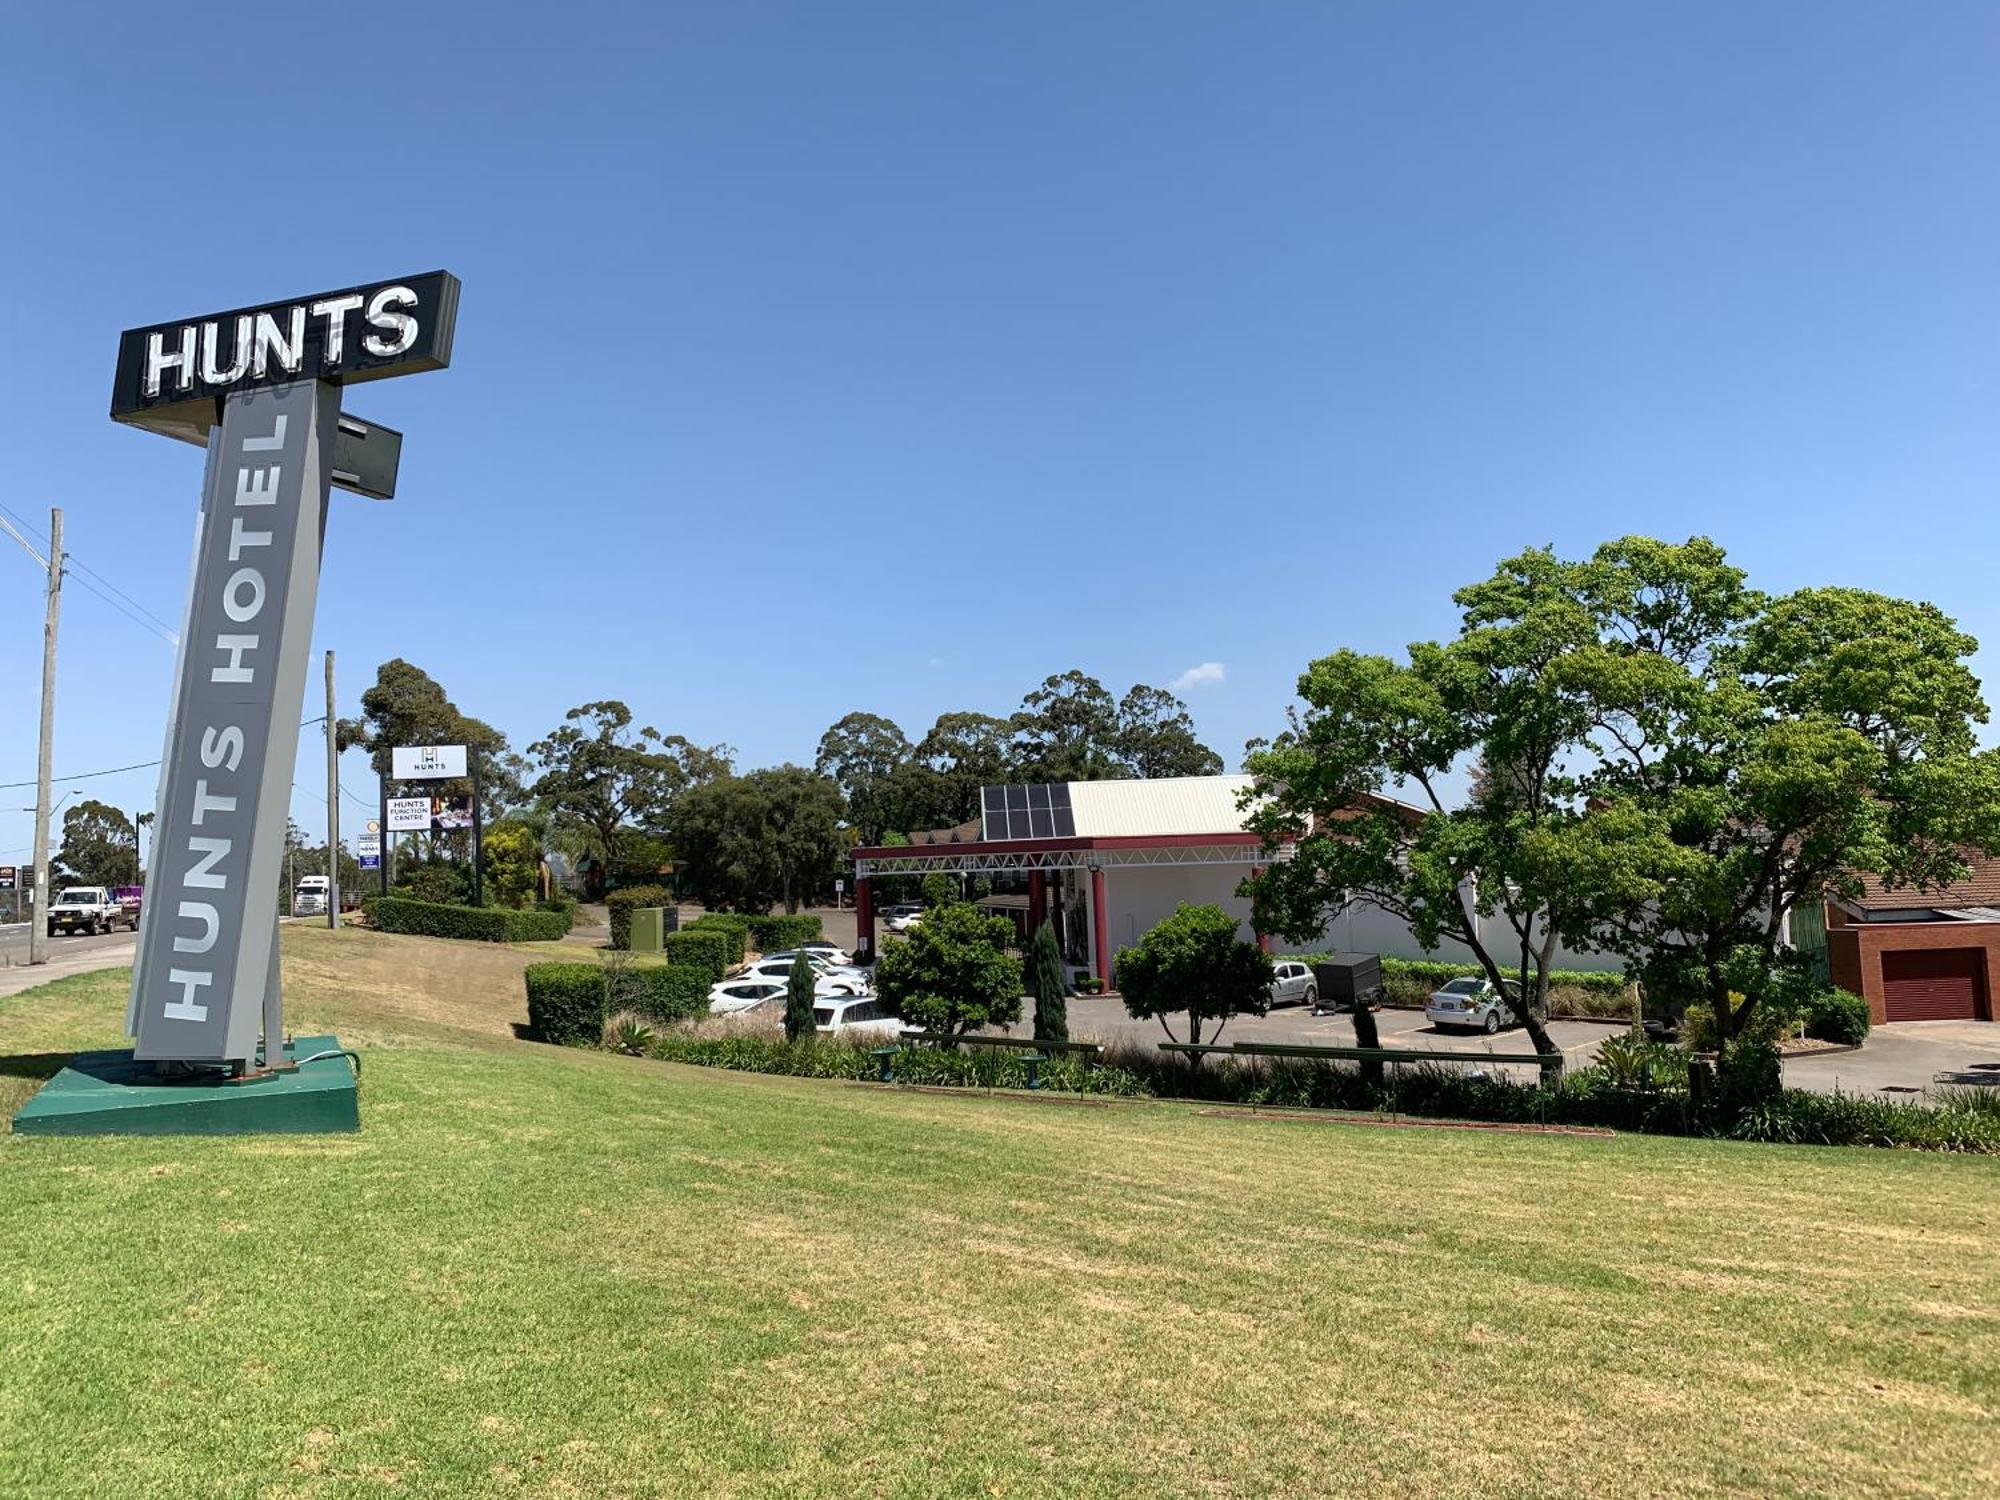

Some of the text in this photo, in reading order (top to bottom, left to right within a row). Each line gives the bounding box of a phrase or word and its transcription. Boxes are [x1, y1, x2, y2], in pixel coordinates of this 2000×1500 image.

[143, 285, 418, 398] HUNTS
[163, 415, 288, 1022] HUNTS HOTEL
[414, 763, 446, 771] HUNTS
